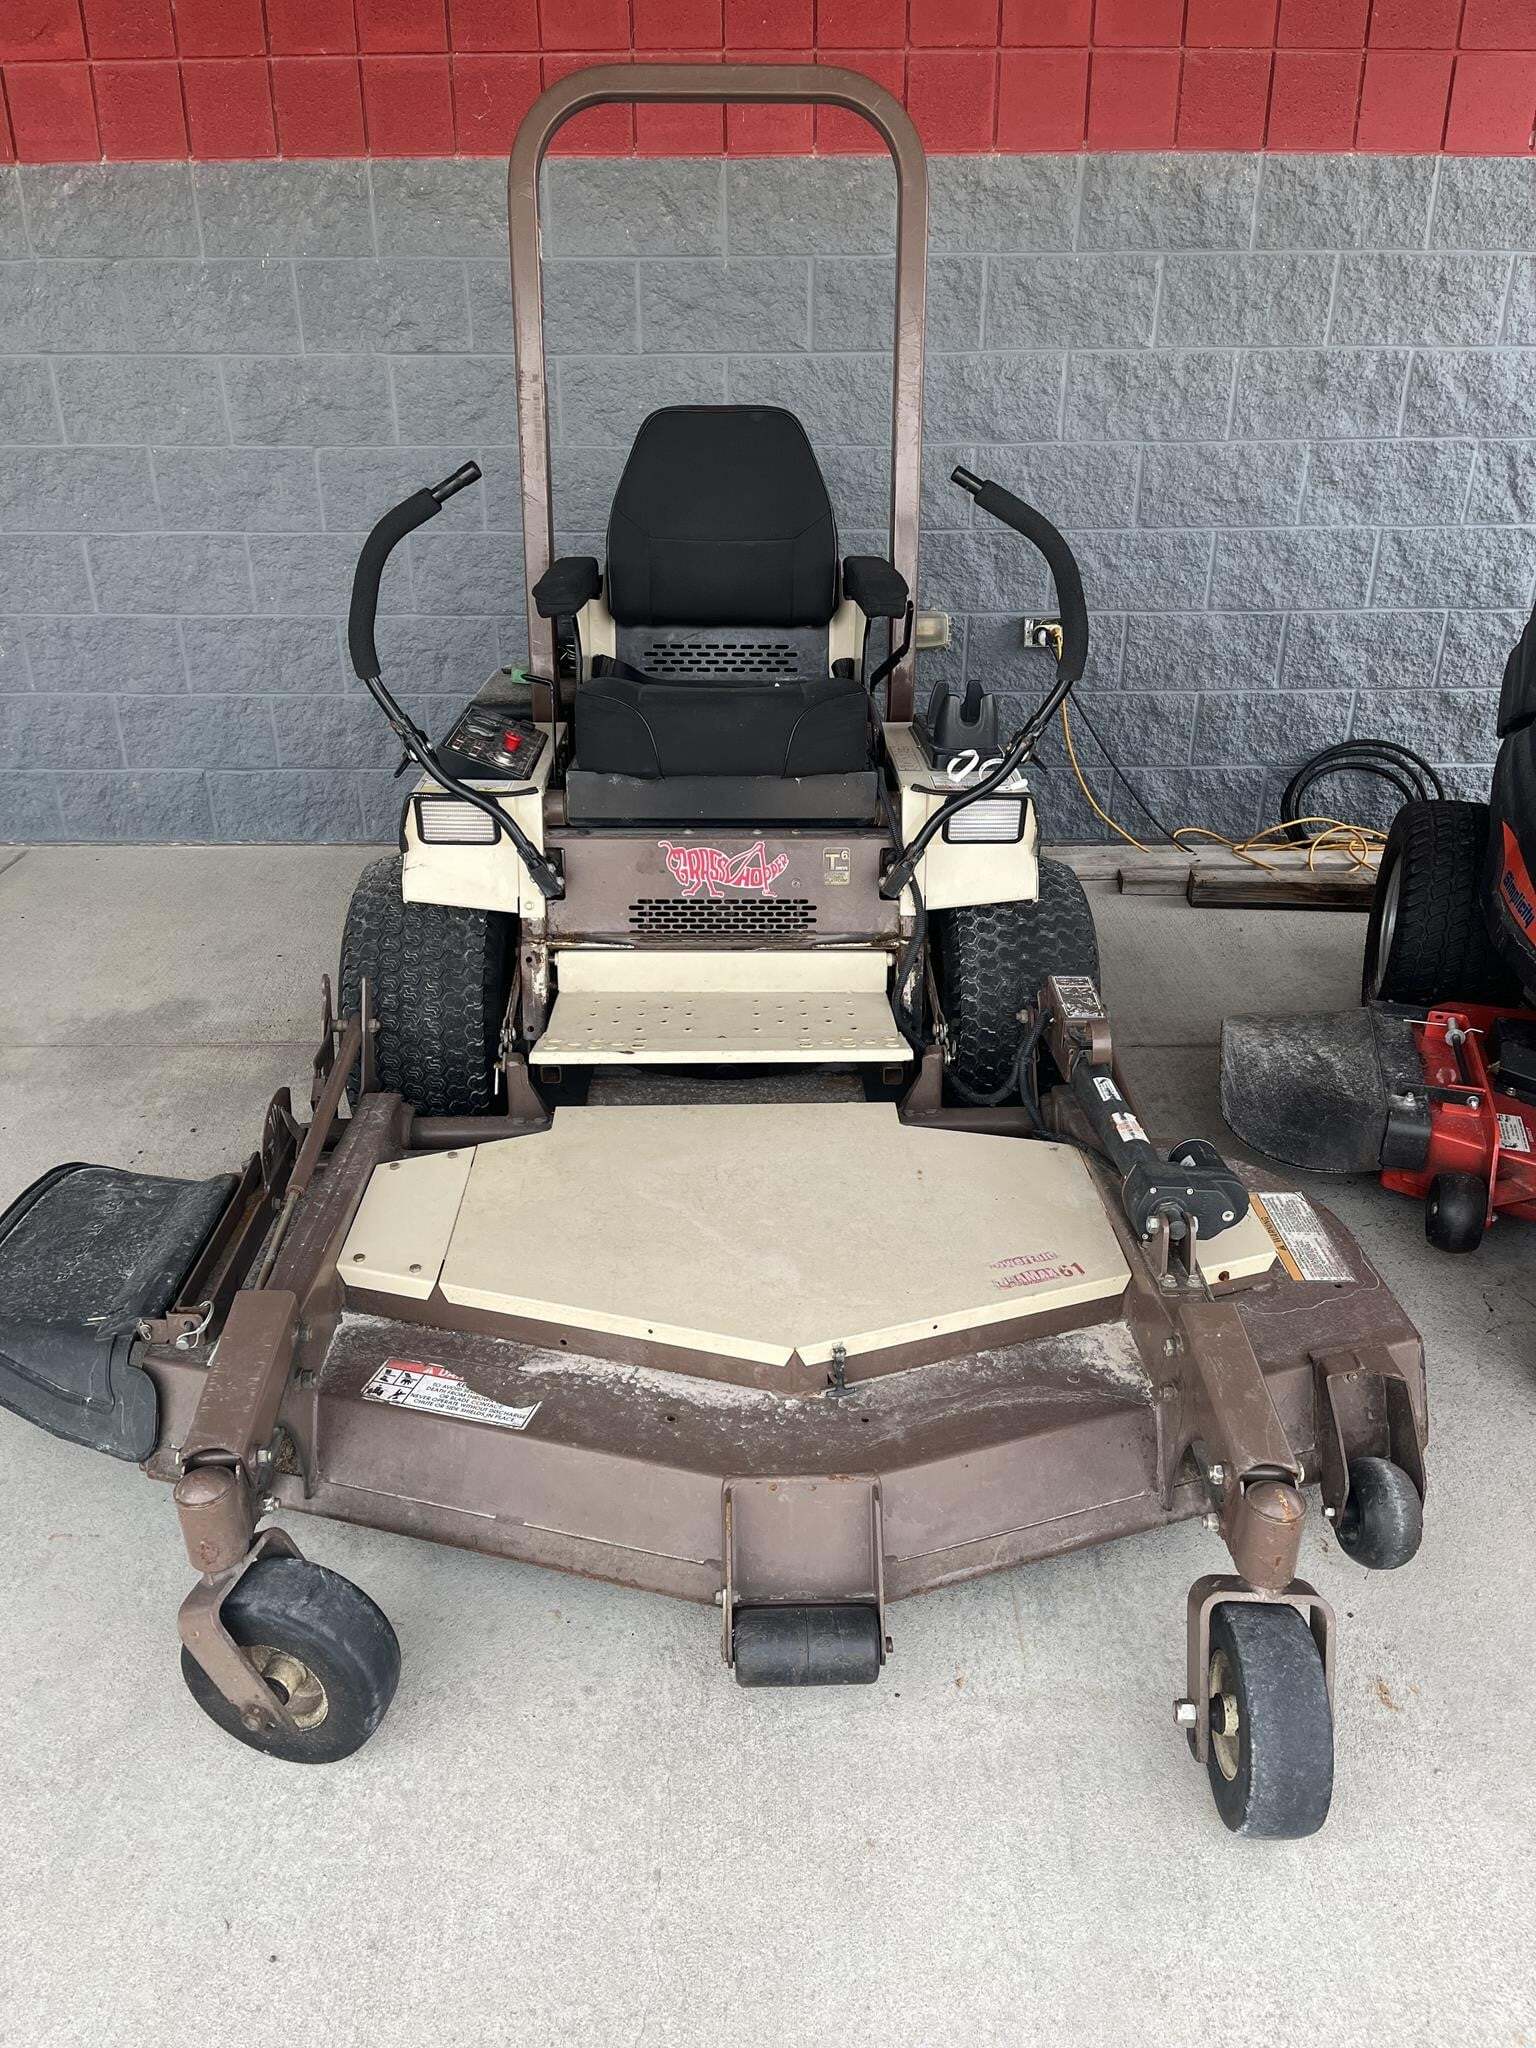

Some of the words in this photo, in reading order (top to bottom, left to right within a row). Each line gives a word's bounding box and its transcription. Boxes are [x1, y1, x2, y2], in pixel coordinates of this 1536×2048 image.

[1503, 870, 1535, 928] simplicity
[1059, 1262, 1086, 1277] 61
[431, 1397, 459, 1406] OPERATE
[460, 1402, 489, 1412] WITHOUT
[488, 1407, 527, 1419] DISCHARGE
